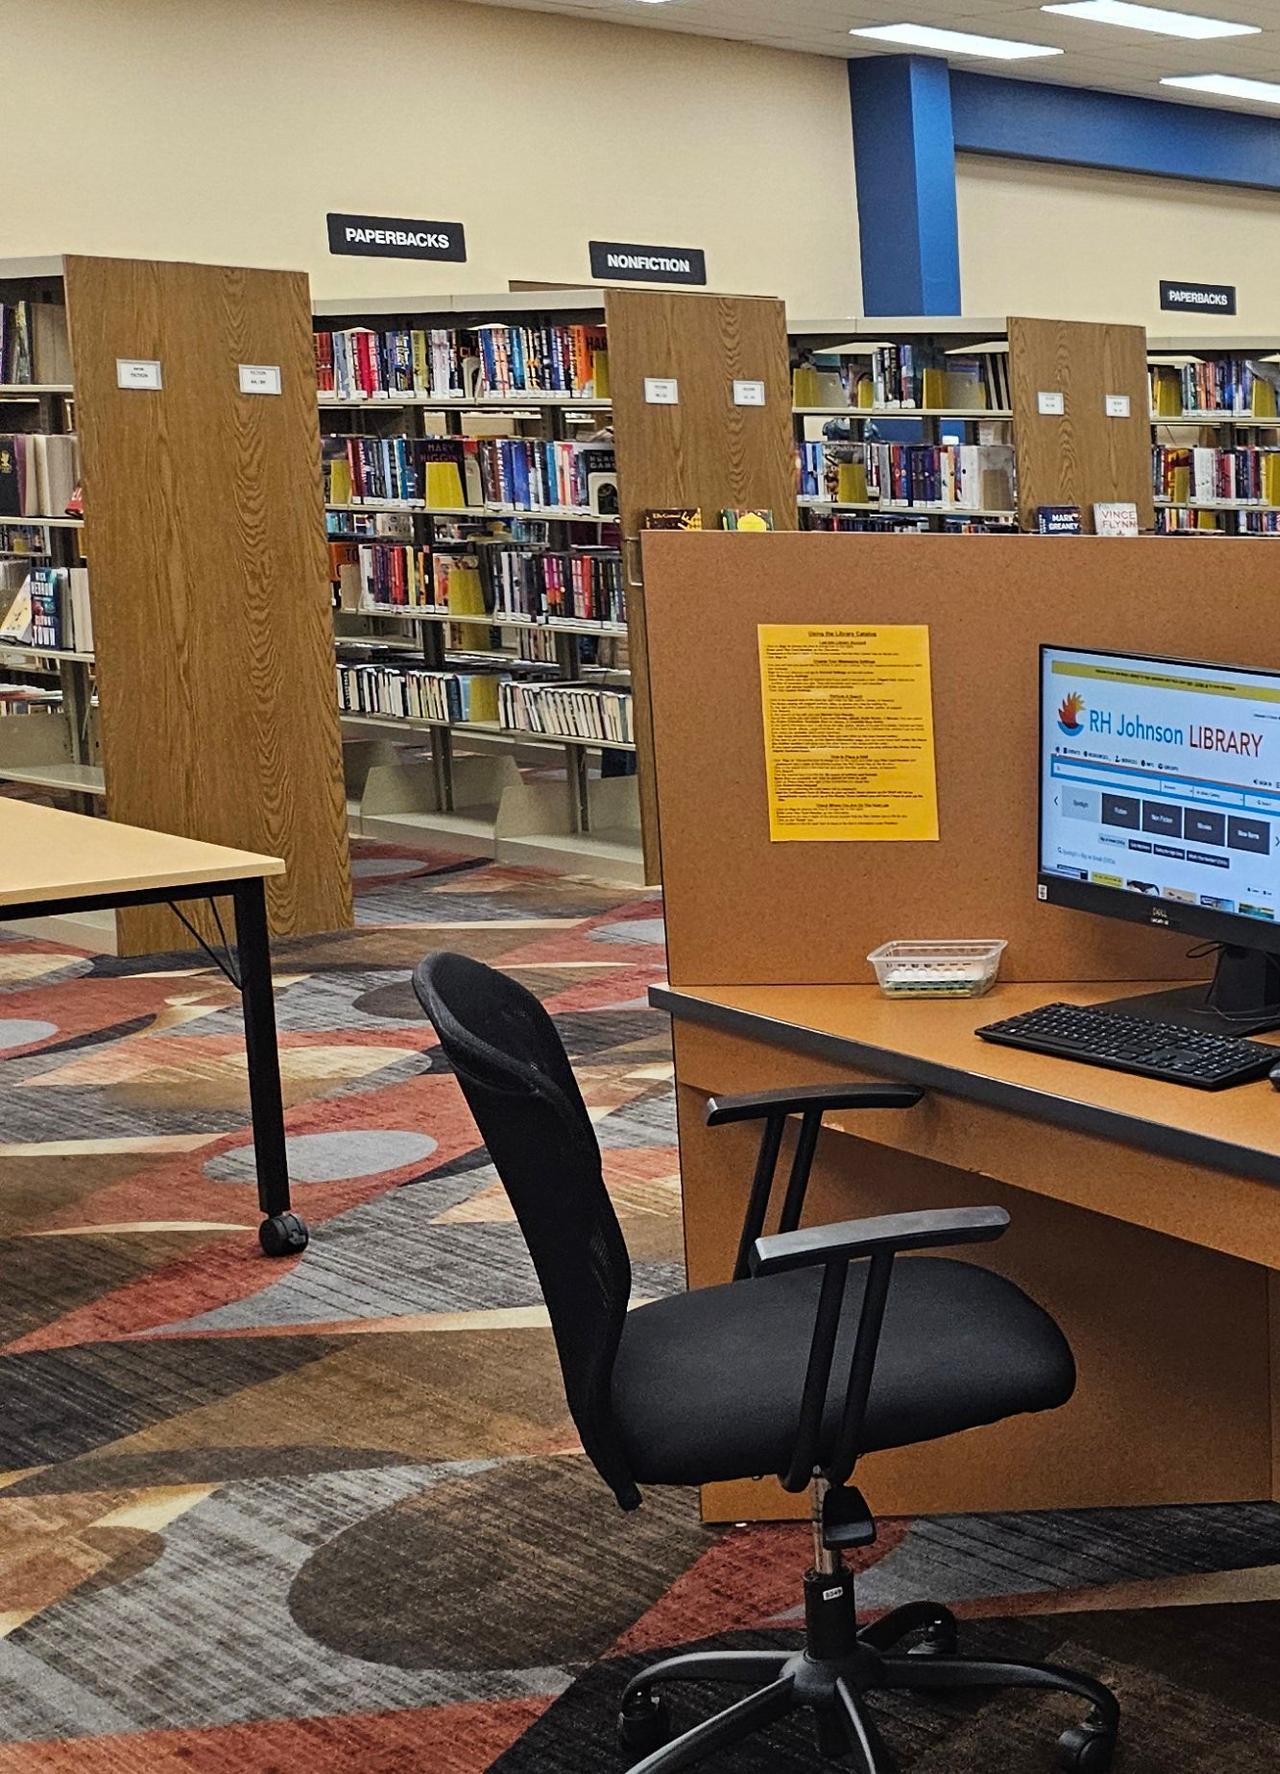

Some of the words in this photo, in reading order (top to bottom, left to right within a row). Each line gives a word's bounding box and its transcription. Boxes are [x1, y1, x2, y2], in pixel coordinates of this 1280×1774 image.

[345, 227, 450, 249] PAPERBACKS
[607, 253, 691, 273] NONFICTION
[1168, 290, 1228, 306] PAPERBACKS
[1102, 510, 1137, 520] VINCE
[1103, 520, 1138, 529] FLYNN
[1089, 709, 1111, 735] RH
[1117, 714, 1183, 746] Johnson
[1189, 724, 1264, 758] LIBRARY
